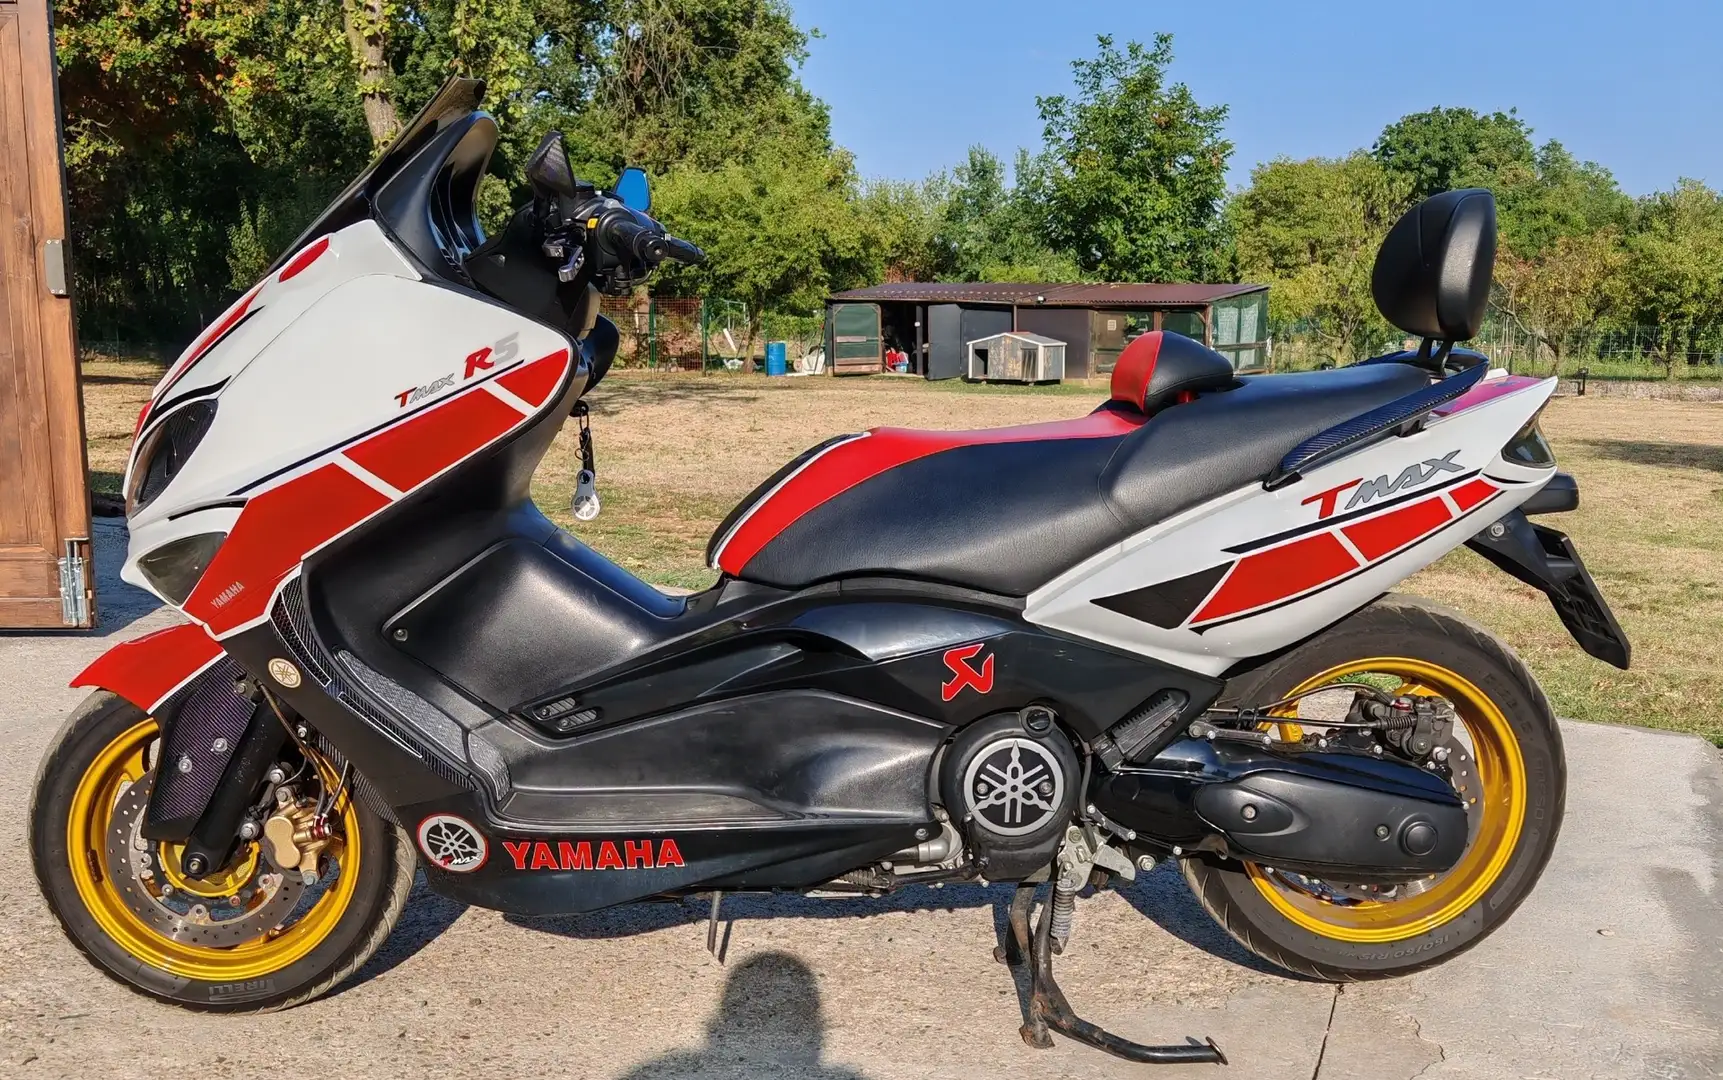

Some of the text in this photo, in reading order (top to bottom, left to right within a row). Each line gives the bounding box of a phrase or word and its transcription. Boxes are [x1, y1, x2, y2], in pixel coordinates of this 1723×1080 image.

[210, 581, 245, 609] YAMAHA
[502, 838, 686, 871] YAMAHA
[208, 978, 276, 1002] PIRELLI
